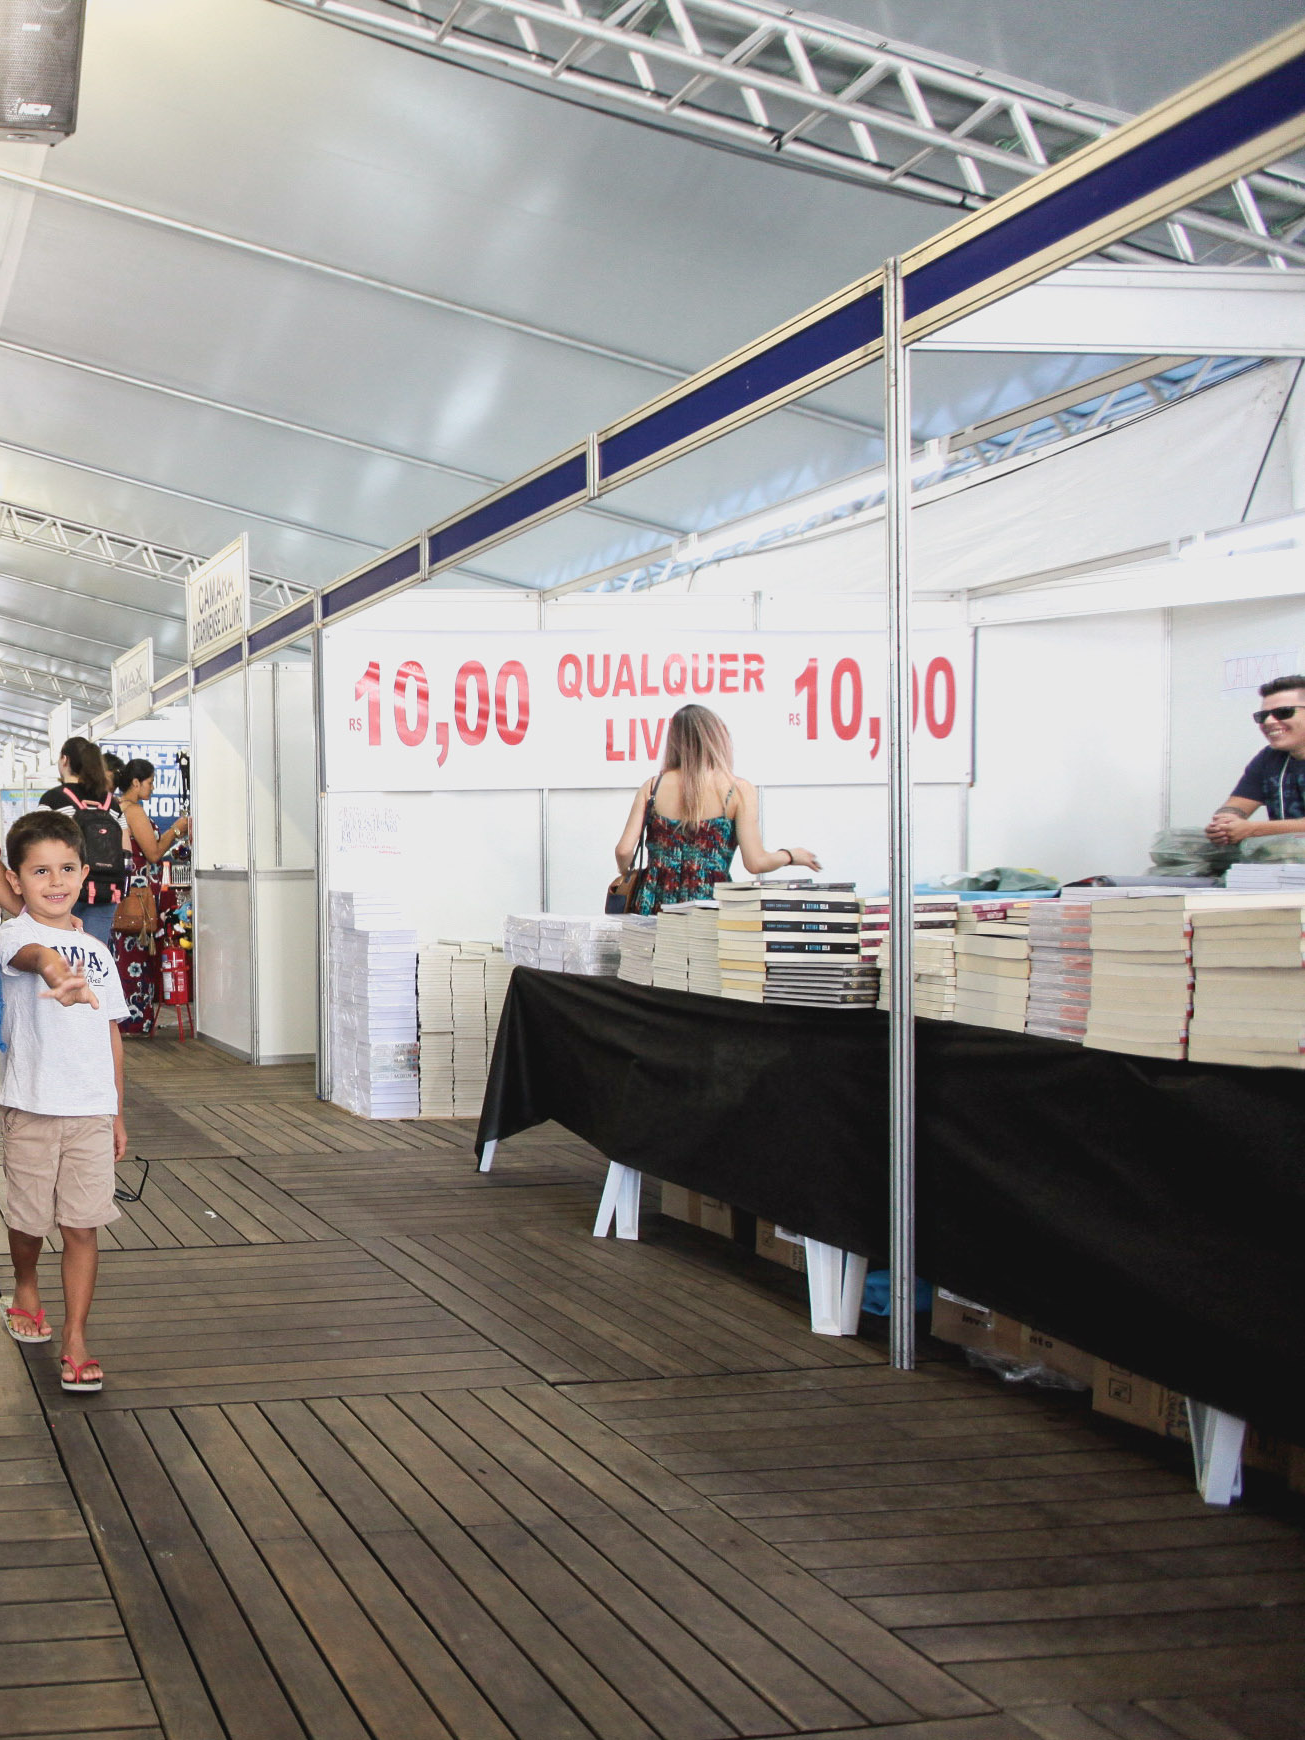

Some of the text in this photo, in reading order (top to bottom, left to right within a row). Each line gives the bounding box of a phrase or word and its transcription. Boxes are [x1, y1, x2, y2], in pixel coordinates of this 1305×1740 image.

[120, 664, 143, 693] MAX
[557, 652, 766, 701] QUALQUER
[348, 717, 363, 732] R$
[354, 660, 530, 768] 10,00
[789, 713, 801, 726] R$
[794, 656, 956, 761] 10,0
[606, 717, 674, 762] LIV
